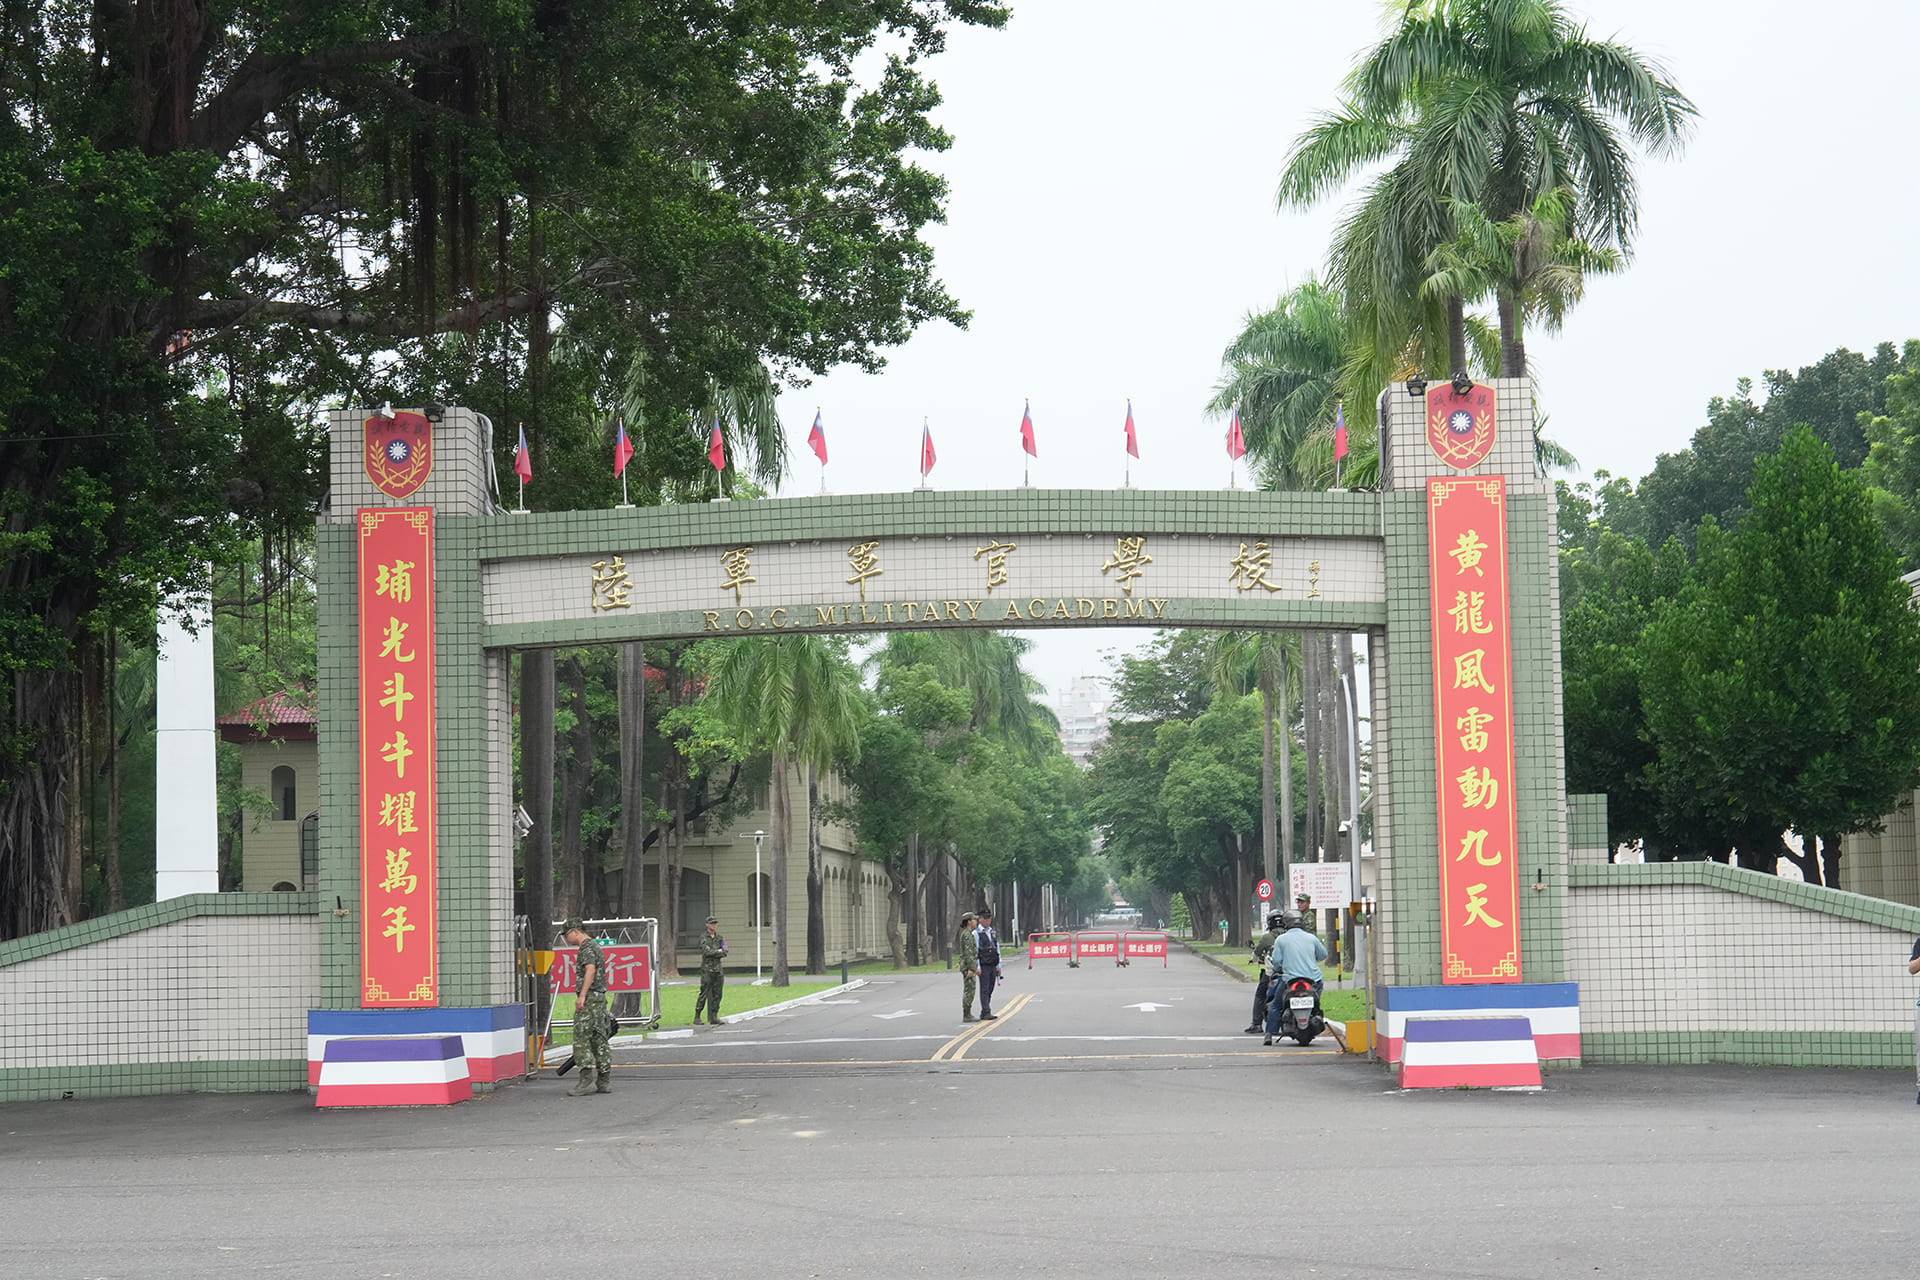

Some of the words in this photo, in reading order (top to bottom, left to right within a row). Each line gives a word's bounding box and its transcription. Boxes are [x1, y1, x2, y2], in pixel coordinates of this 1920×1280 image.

[592, 536, 1282, 613] 陸軍軍官學校
[702, 608, 800, 632] R.O.C.
[815, 600, 982, 626] MILITARY
[1003, 598, 1168, 621] ACADEMY
[375, 559, 419, 953] 埔光斗牛耀萬年
[1447, 529, 1504, 928] 黃龍風雷動九天
[1260, 885, 1270, 896] 20
